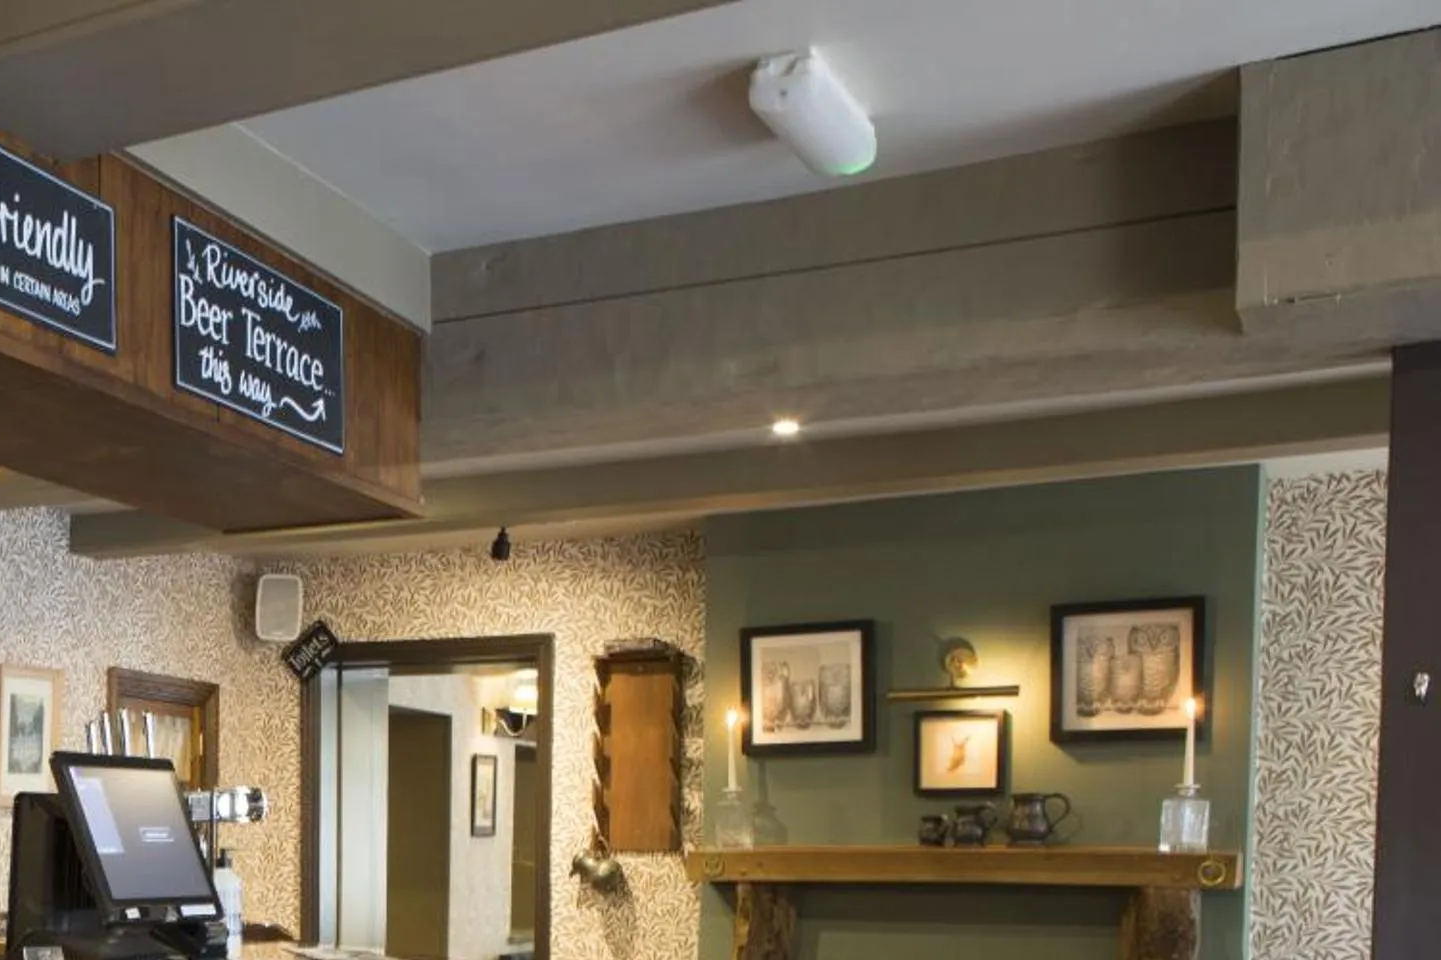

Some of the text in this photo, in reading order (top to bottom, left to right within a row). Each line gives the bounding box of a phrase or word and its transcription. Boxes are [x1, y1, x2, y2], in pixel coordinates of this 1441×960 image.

[12, 269, 53, 303] CERTAIN
[51, 287, 82, 318] AREAS
[178, 273, 234, 345] Beer
[201, 242, 299, 323] Riverside
[197, 346, 277, 419] this way
